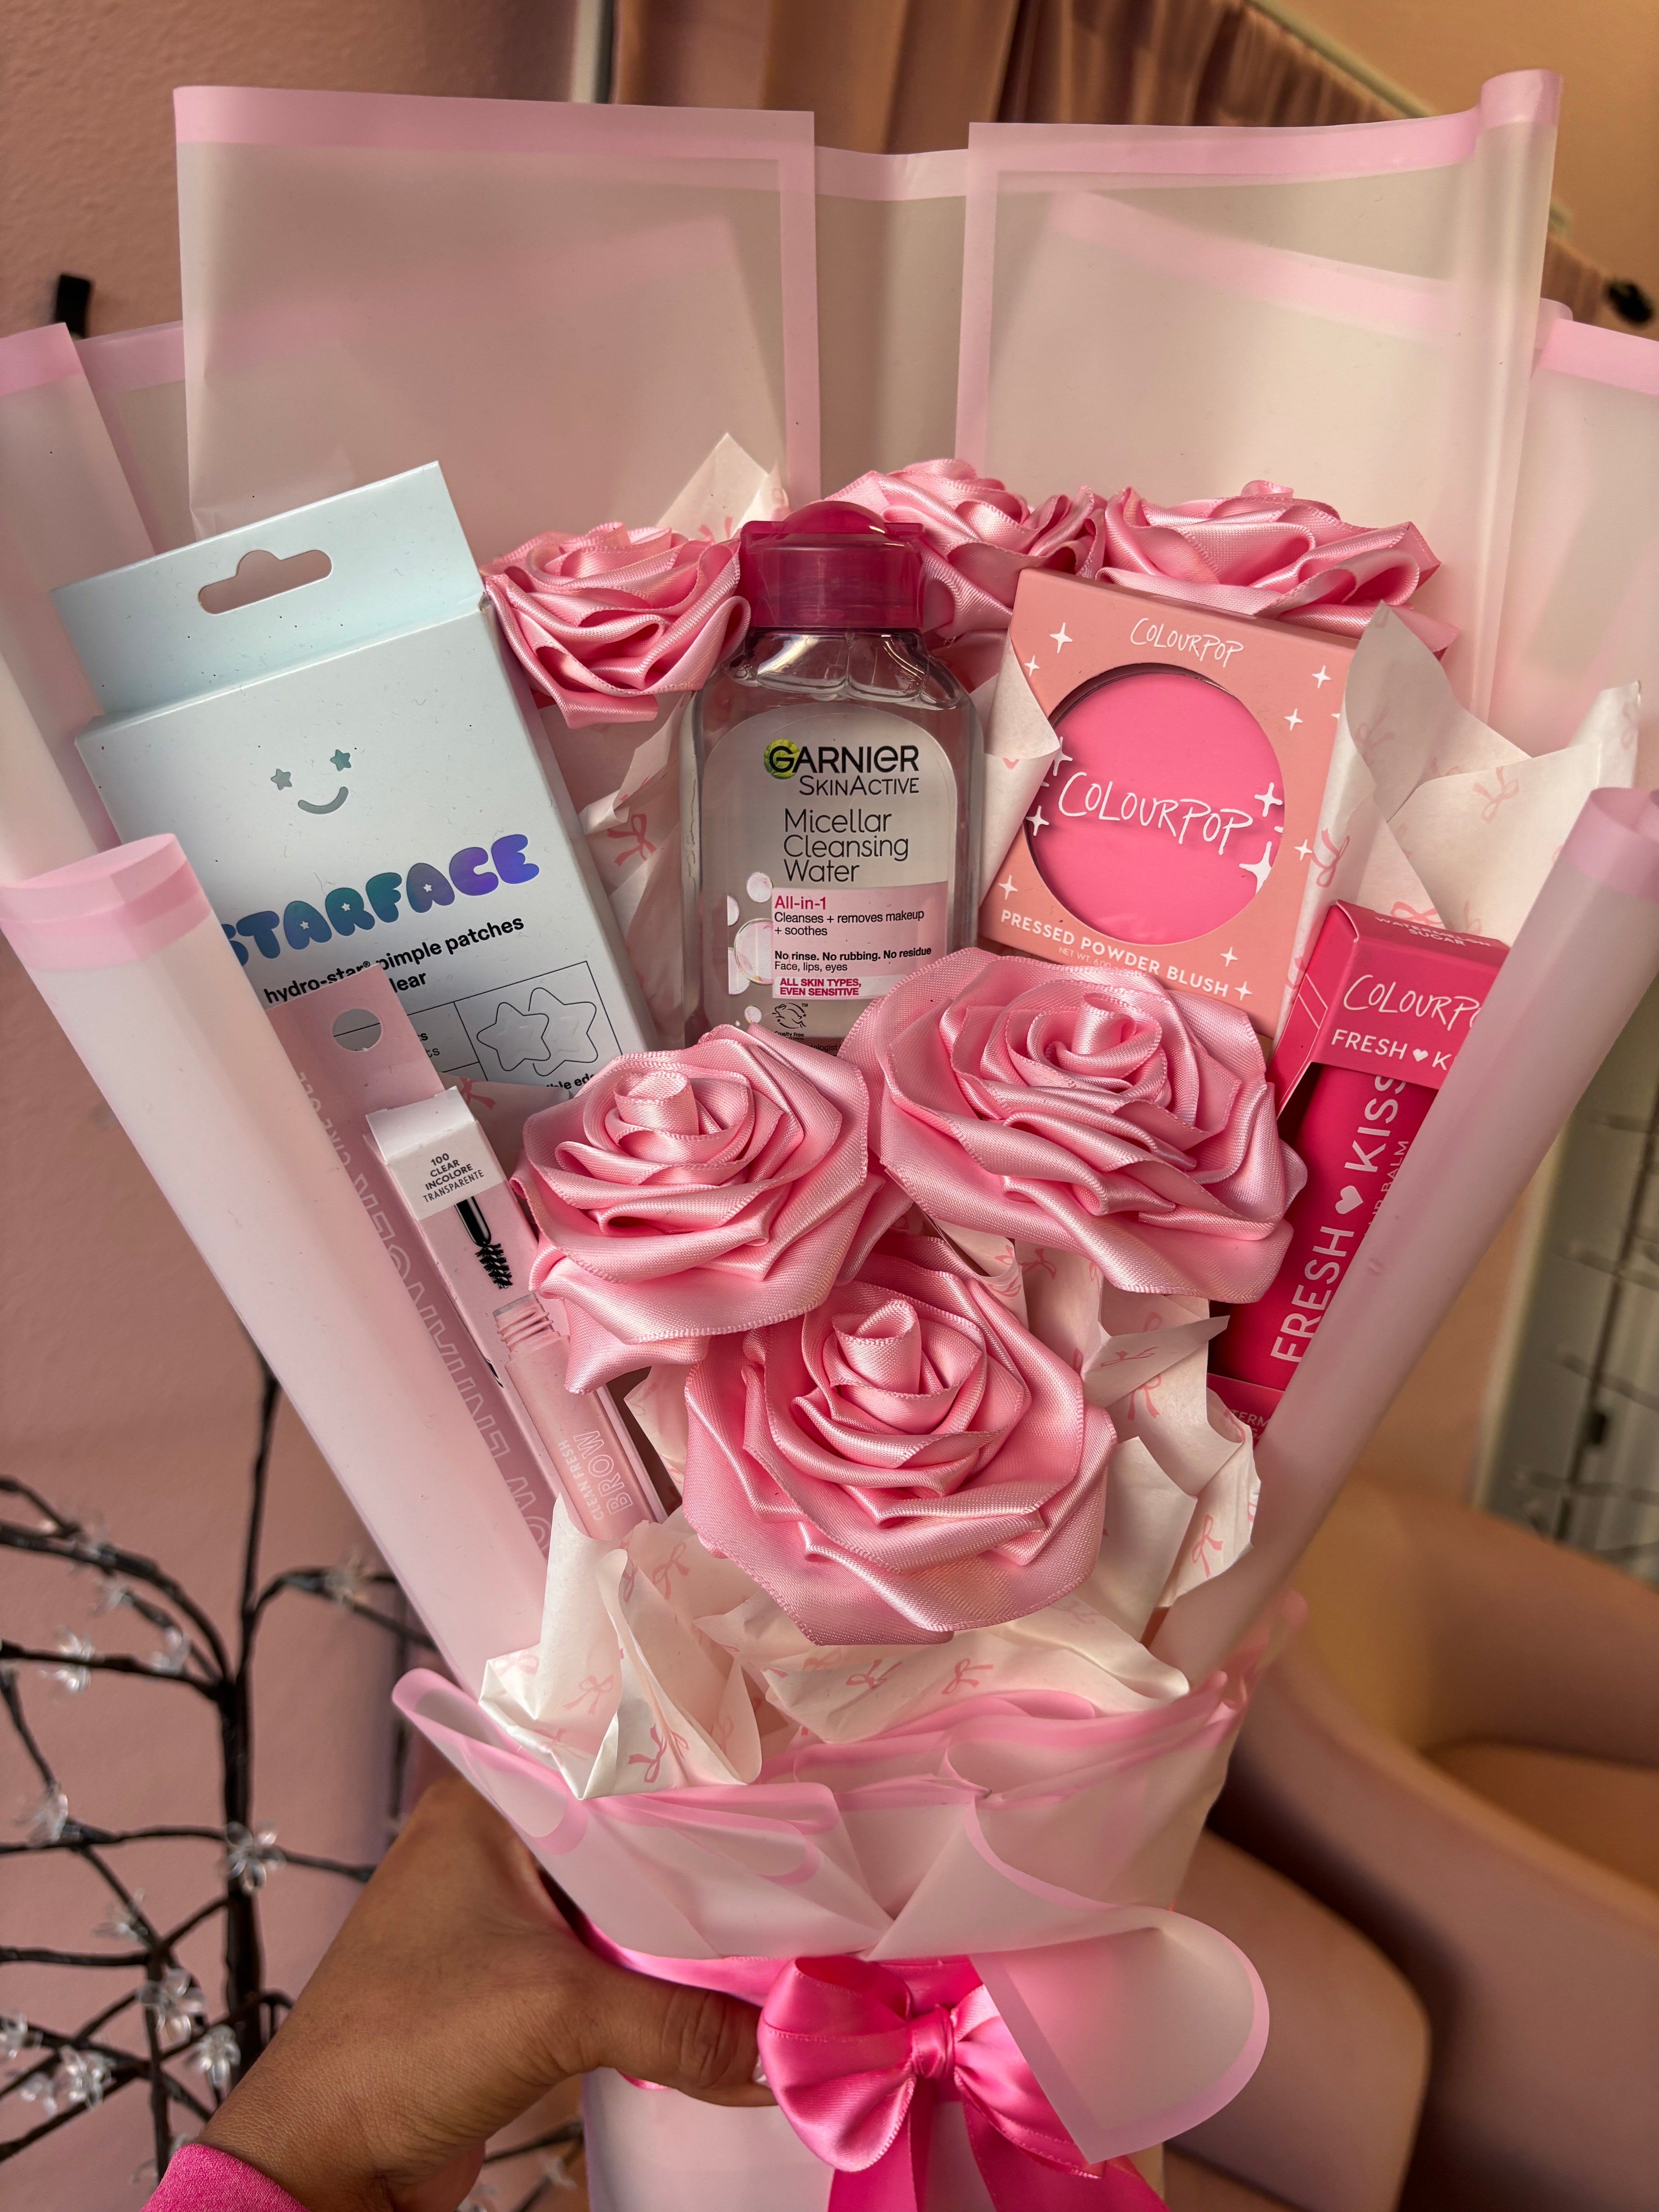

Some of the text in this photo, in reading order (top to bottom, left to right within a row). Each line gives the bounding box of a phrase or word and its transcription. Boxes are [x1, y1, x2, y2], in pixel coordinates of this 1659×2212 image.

[1130, 617, 1243, 667] COLOURPOP
[785, 808, 892, 833] Micellar
[1058, 771, 1253, 855] COLOURPOP
[784, 835, 908, 862] Cleansing
[783, 859, 860, 882] Water
[775, 895, 826, 910] All-in-1
[775, 912, 824, 923] Cleanses
[838, 914, 883, 923] removes
[886, 910, 924, 921] makeup
[785, 926, 828, 936] soothes
[1375, 917, 1490, 946] WATERMELON
[1409, 929, 1465, 946] SUGAR
[376, 942, 442, 970] pimple
[445, 918, 524, 955] patches
[775, 947, 931, 961] No rinse. No rubbing. No residue
[1001, 909, 1229, 997] PRESSED POWDER BLUSH
[1059, 946, 1074, 957] NET
[775, 961, 847, 973] Face, lips, eyes
[389, 973, 426, 993] lear
[780, 978, 861, 988] ALL SKIN TYPES,
[780, 987, 859, 996] EVEN SENSITIVE
[1343, 974, 1480, 1031] COLOURP
[1332, 1029, 1408, 1060] FRESH
[430, 1159, 460, 1177] CLEAR
[431, 1153, 449, 1166] 100
[423, 1170, 484, 1202] TRANSPARENTE
[425, 1164, 473, 1190] INCOLORE
[1270, 1226, 1354, 1362] FRESH
[558, 1440, 604, 1521] CLEAN FRESH
[573, 1431, 633, 1515] BROW
